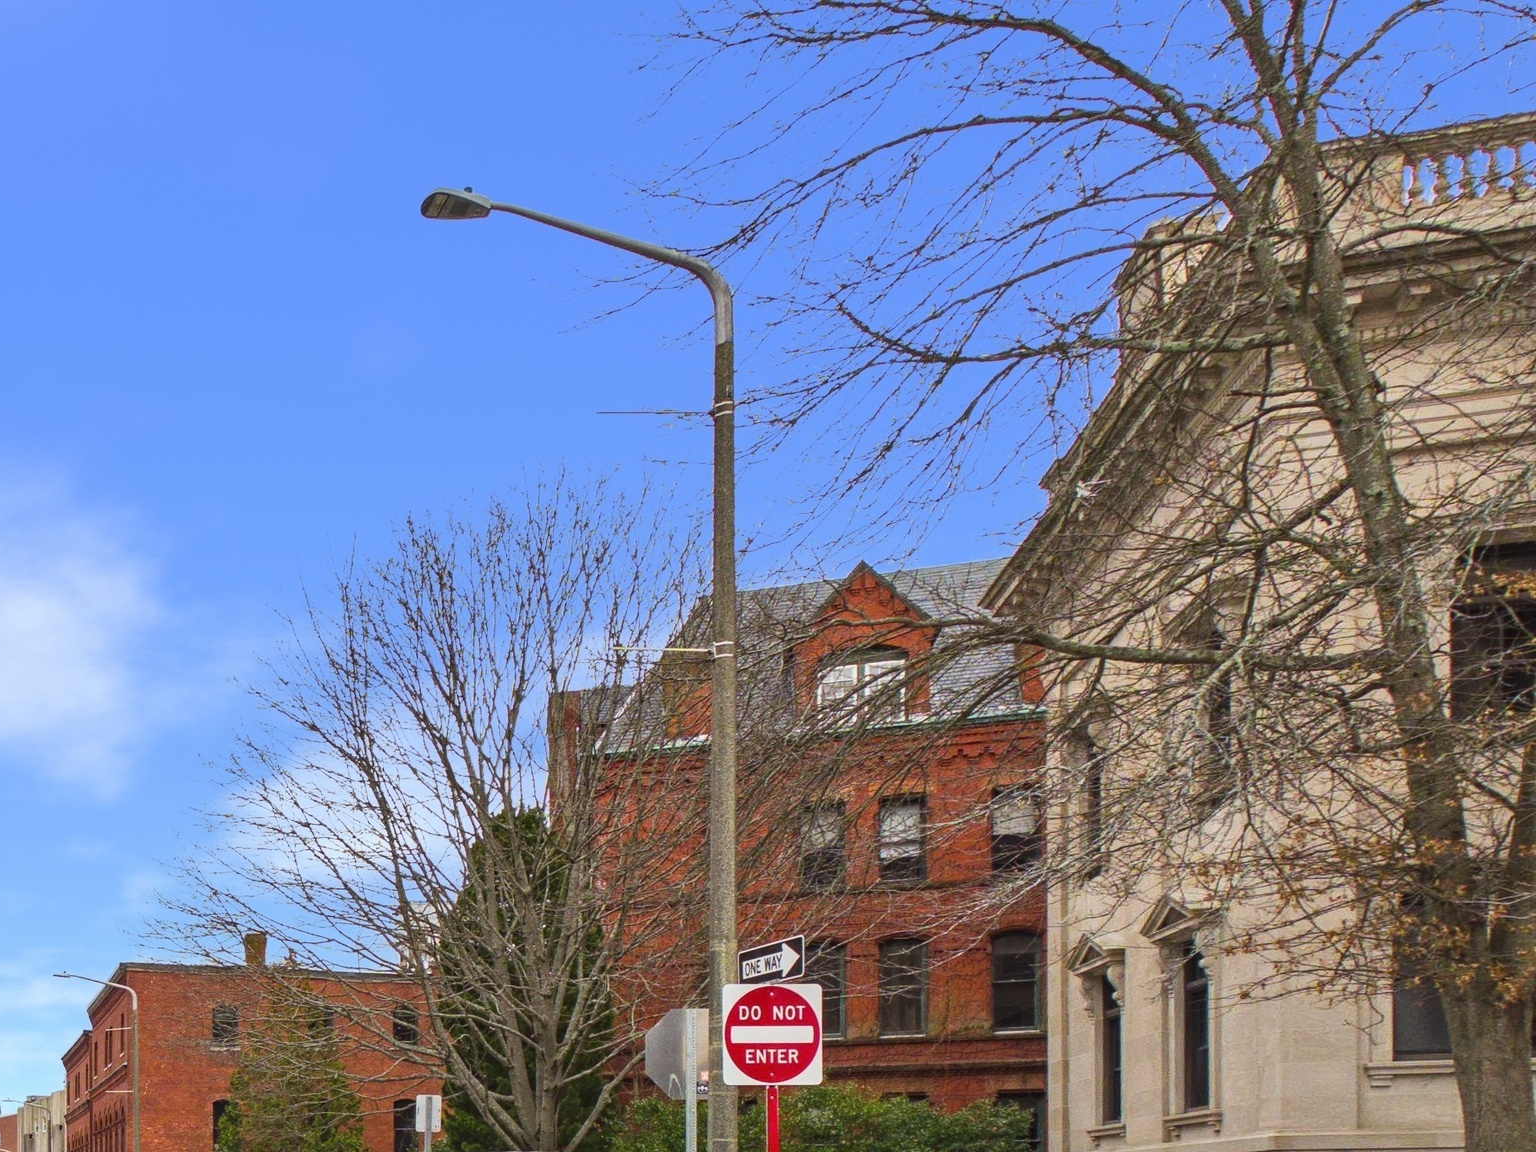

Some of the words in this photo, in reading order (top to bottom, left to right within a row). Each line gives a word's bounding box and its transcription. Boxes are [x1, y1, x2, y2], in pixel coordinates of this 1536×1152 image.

[745, 960, 761, 977] ONE
[764, 954, 783, 972] WAY
[739, 1005, 762, 1020] DO
[773, 1005, 805, 1021] NOT
[745, 1049, 799, 1064] ENTER
